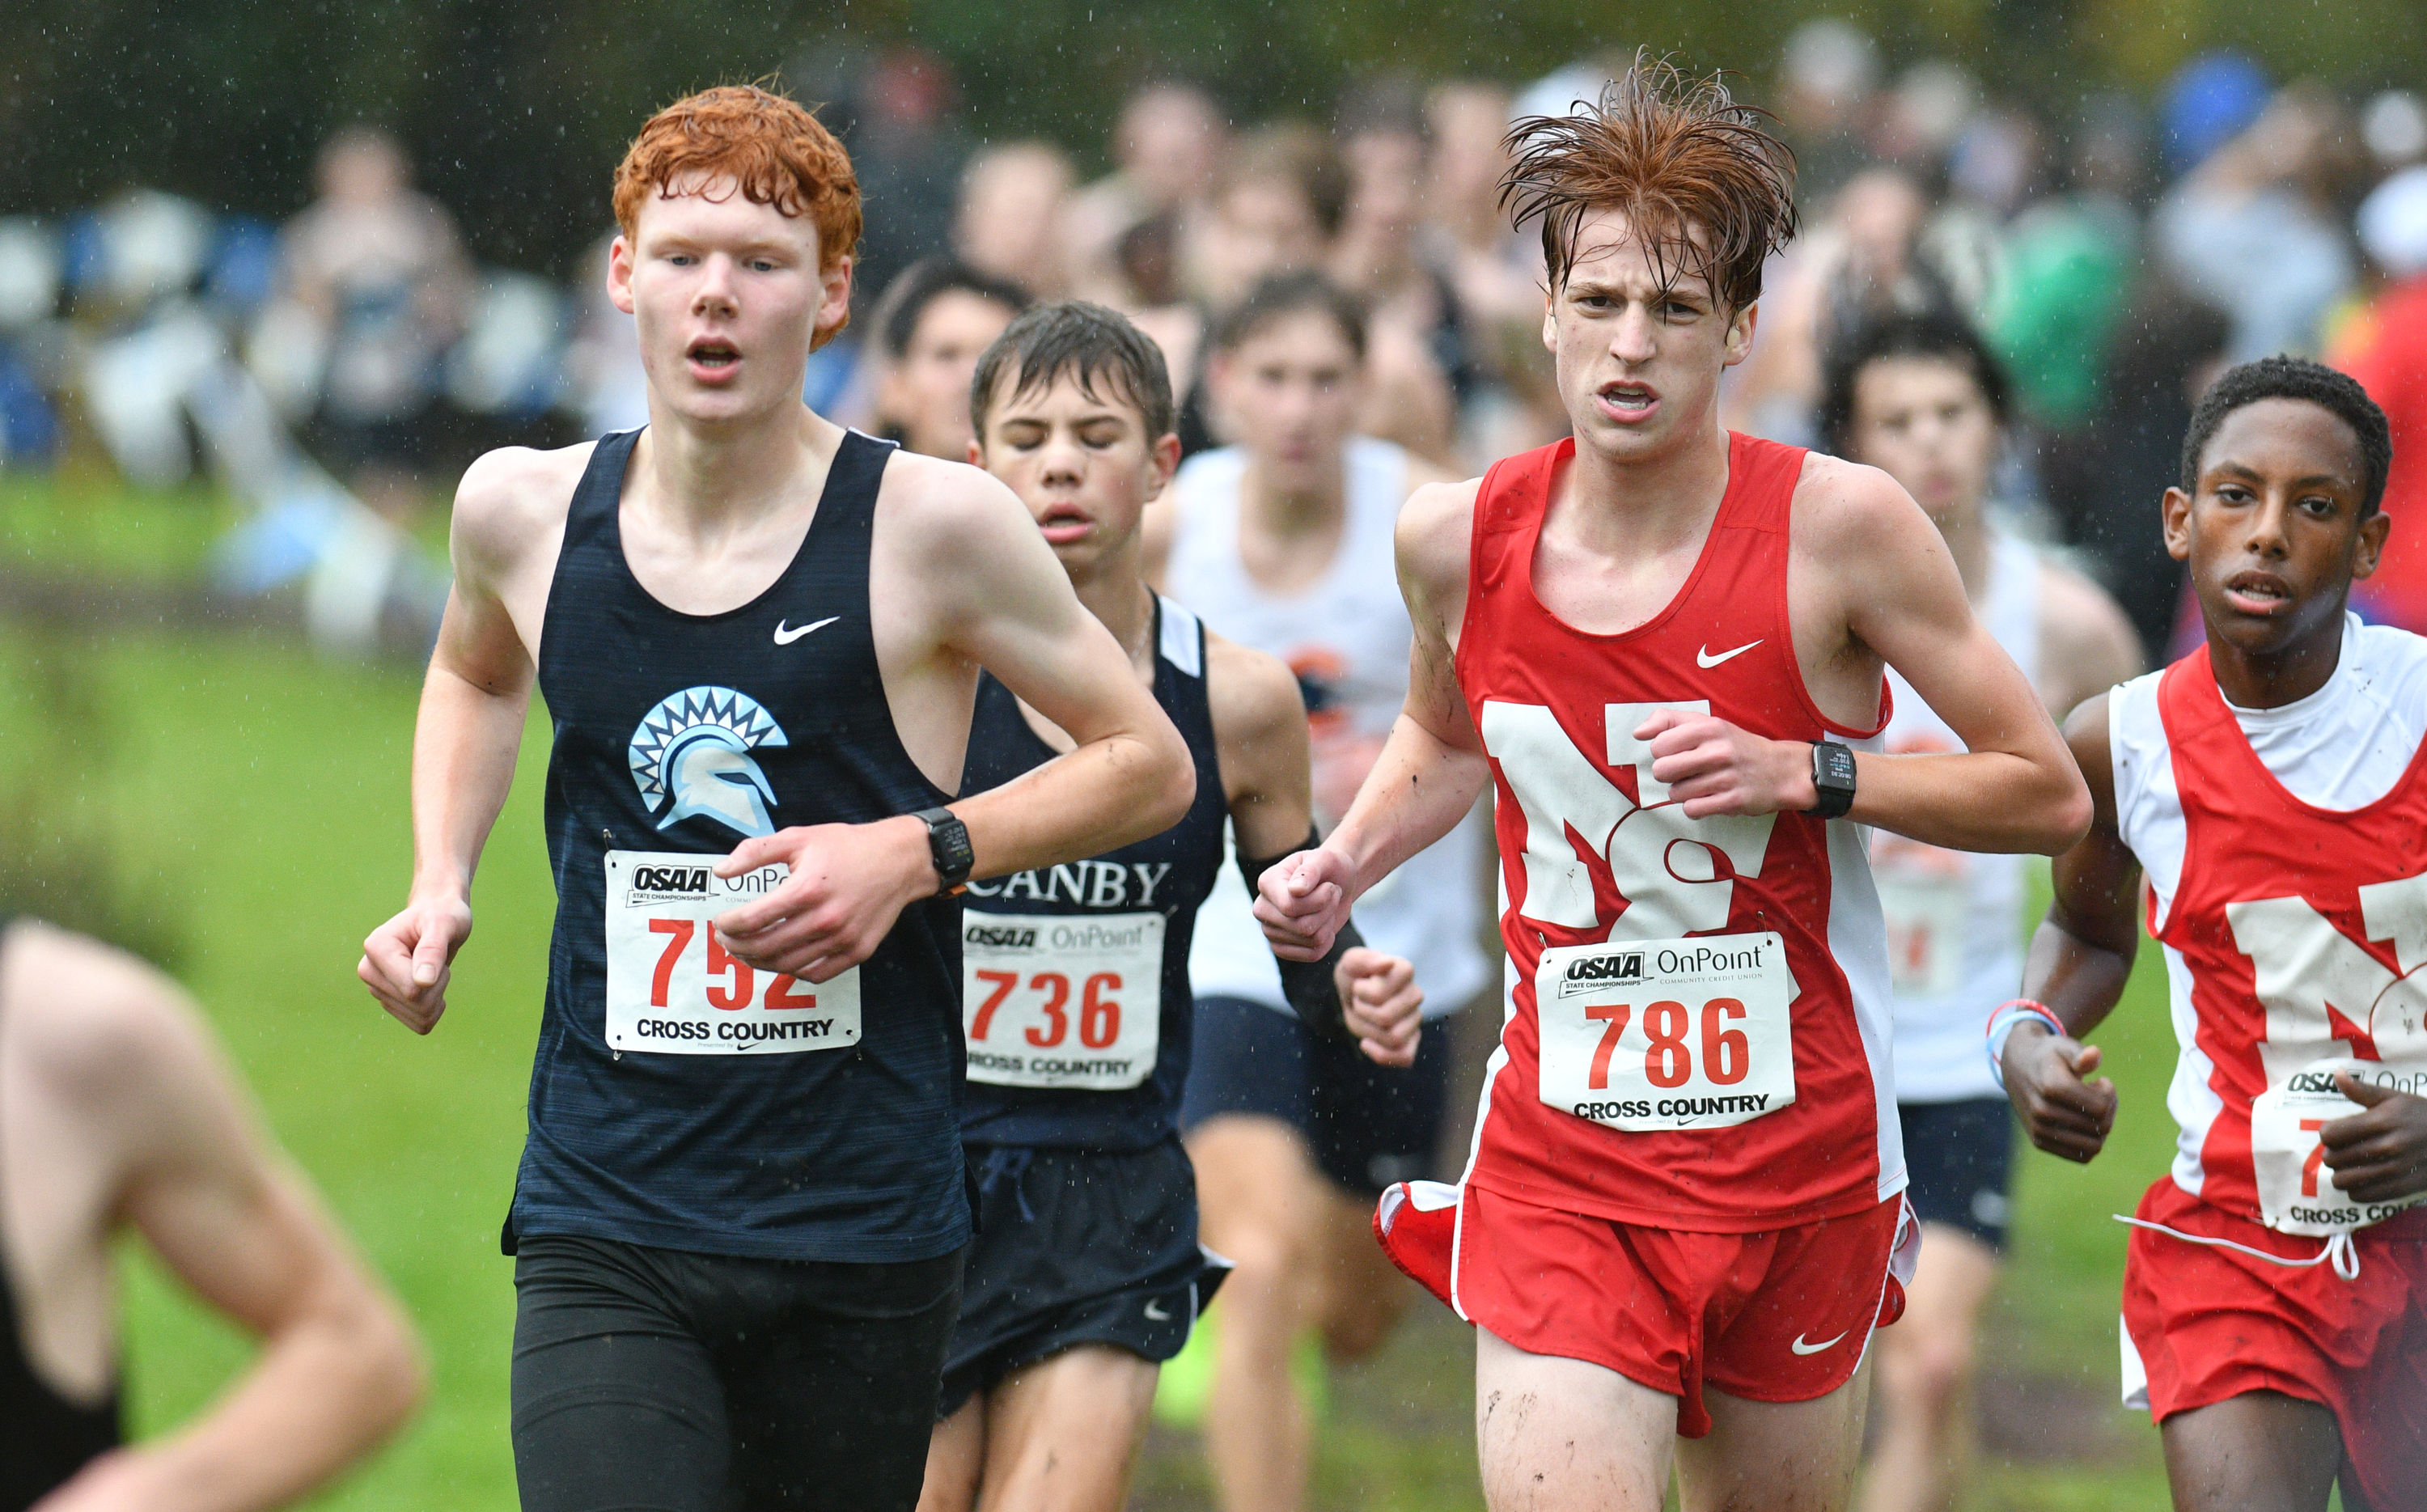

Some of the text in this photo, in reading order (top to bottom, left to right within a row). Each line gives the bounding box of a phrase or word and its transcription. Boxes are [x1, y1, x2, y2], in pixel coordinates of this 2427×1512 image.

[634, 867, 709, 892] OSAA
[651, 893, 707, 902] CHAMPIONSHIPS
[965, 924, 1142, 950] OSAA OnPoint
[1567, 946, 1763, 980] OSAA OnPoint
[1586, 980, 1641, 988] CHAMPIONSHIPS
[1659, 972, 1764, 985] COMMUNITY CREDIT UNION
[970, 968, 1123, 1049] 736
[637, 1018, 835, 1040] CROSS COUNTRY
[1584, 997, 1750, 1090] 786
[968, 1052, 1133, 1075] ROSS COUNTRY
[2287, 1072, 2361, 1093] OSA
[1574, 1094, 1770, 1120] CROSS COUNTRY
[2290, 1205, 2360, 1225] CROSS
